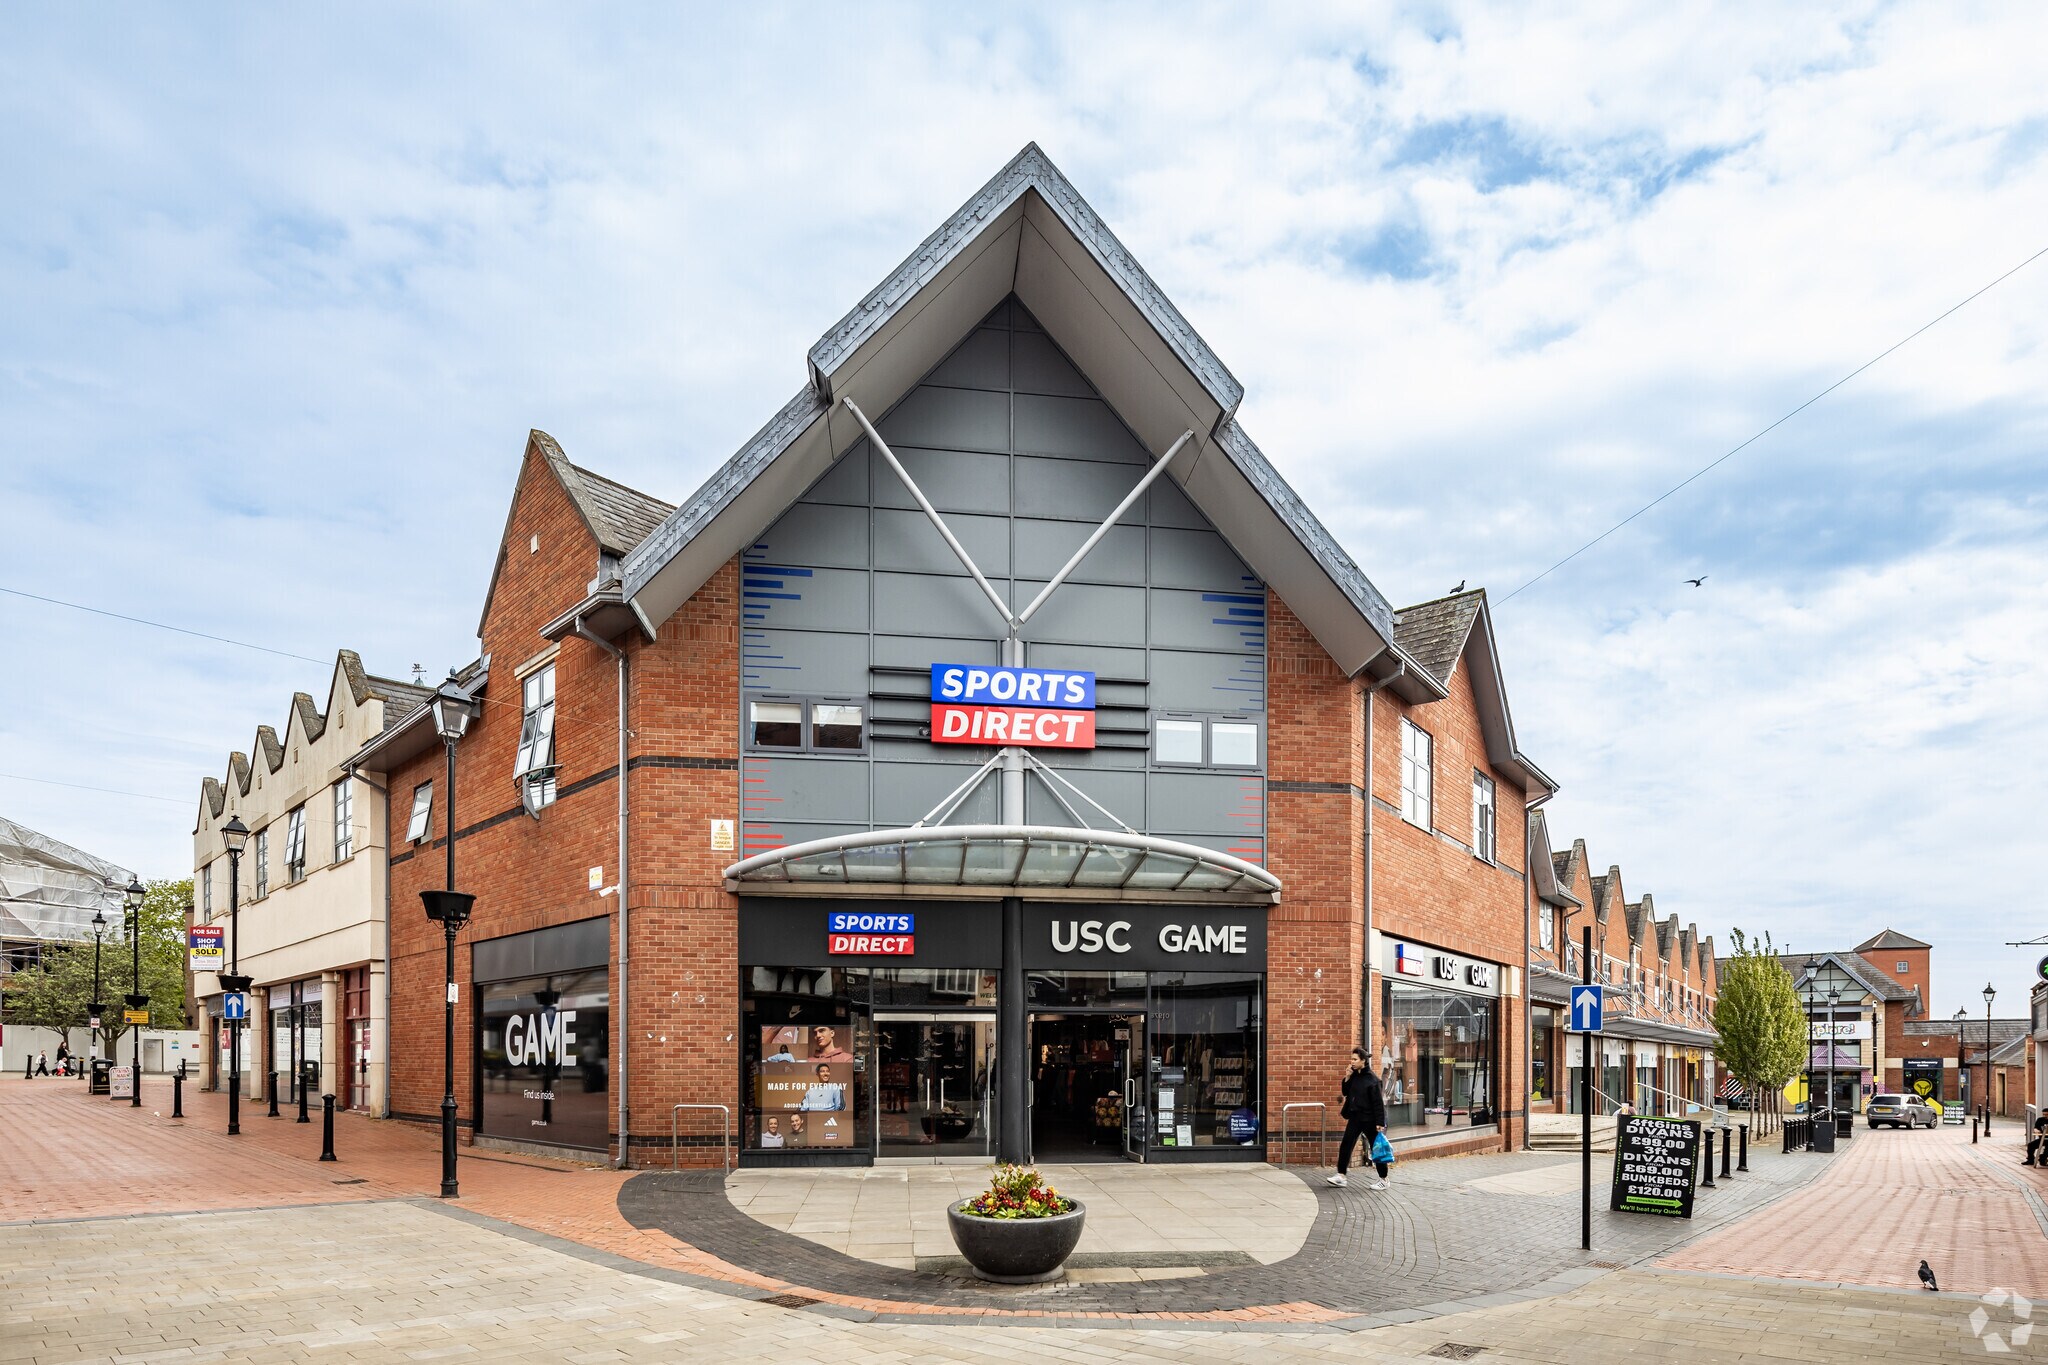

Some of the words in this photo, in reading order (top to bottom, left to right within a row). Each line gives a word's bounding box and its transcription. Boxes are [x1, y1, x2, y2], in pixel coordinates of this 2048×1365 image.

[942, 669, 1085, 703] SPORTS
[942, 709, 1085, 743] DIRECT
[834, 915, 909, 931] SPORTS
[1051, 920, 1132, 953] USC
[1159, 924, 1247, 954] GAME
[834, 937, 909, 952] DIRECT
[1440, 957, 1458, 980] USC
[1472, 964, 1492, 987] GAME
[505, 1010, 577, 1067] GAME
[767, 1083, 789, 1091] MADE
[792, 1083, 806, 1091] FOR
[809, 1083, 848, 1091] EVERYDAY
[523, 1089, 534, 1099] Find
[540, 1090, 555, 1100] inside.
[1626, 1125, 1694, 1138] DIVANS
[1630, 1119, 1691, 1131] 4ft6ins
[1631, 1137, 1685, 1149] £99.00
[1644, 1146, 1668, 1156] 3ft
[1623, 1153, 1691, 1166] DIVANS
[1625, 1164, 1683, 1176] £69.00
[1622, 1173, 1689, 1186] BUNKBEDS
[1628, 1185, 1682, 1198] £120.00
